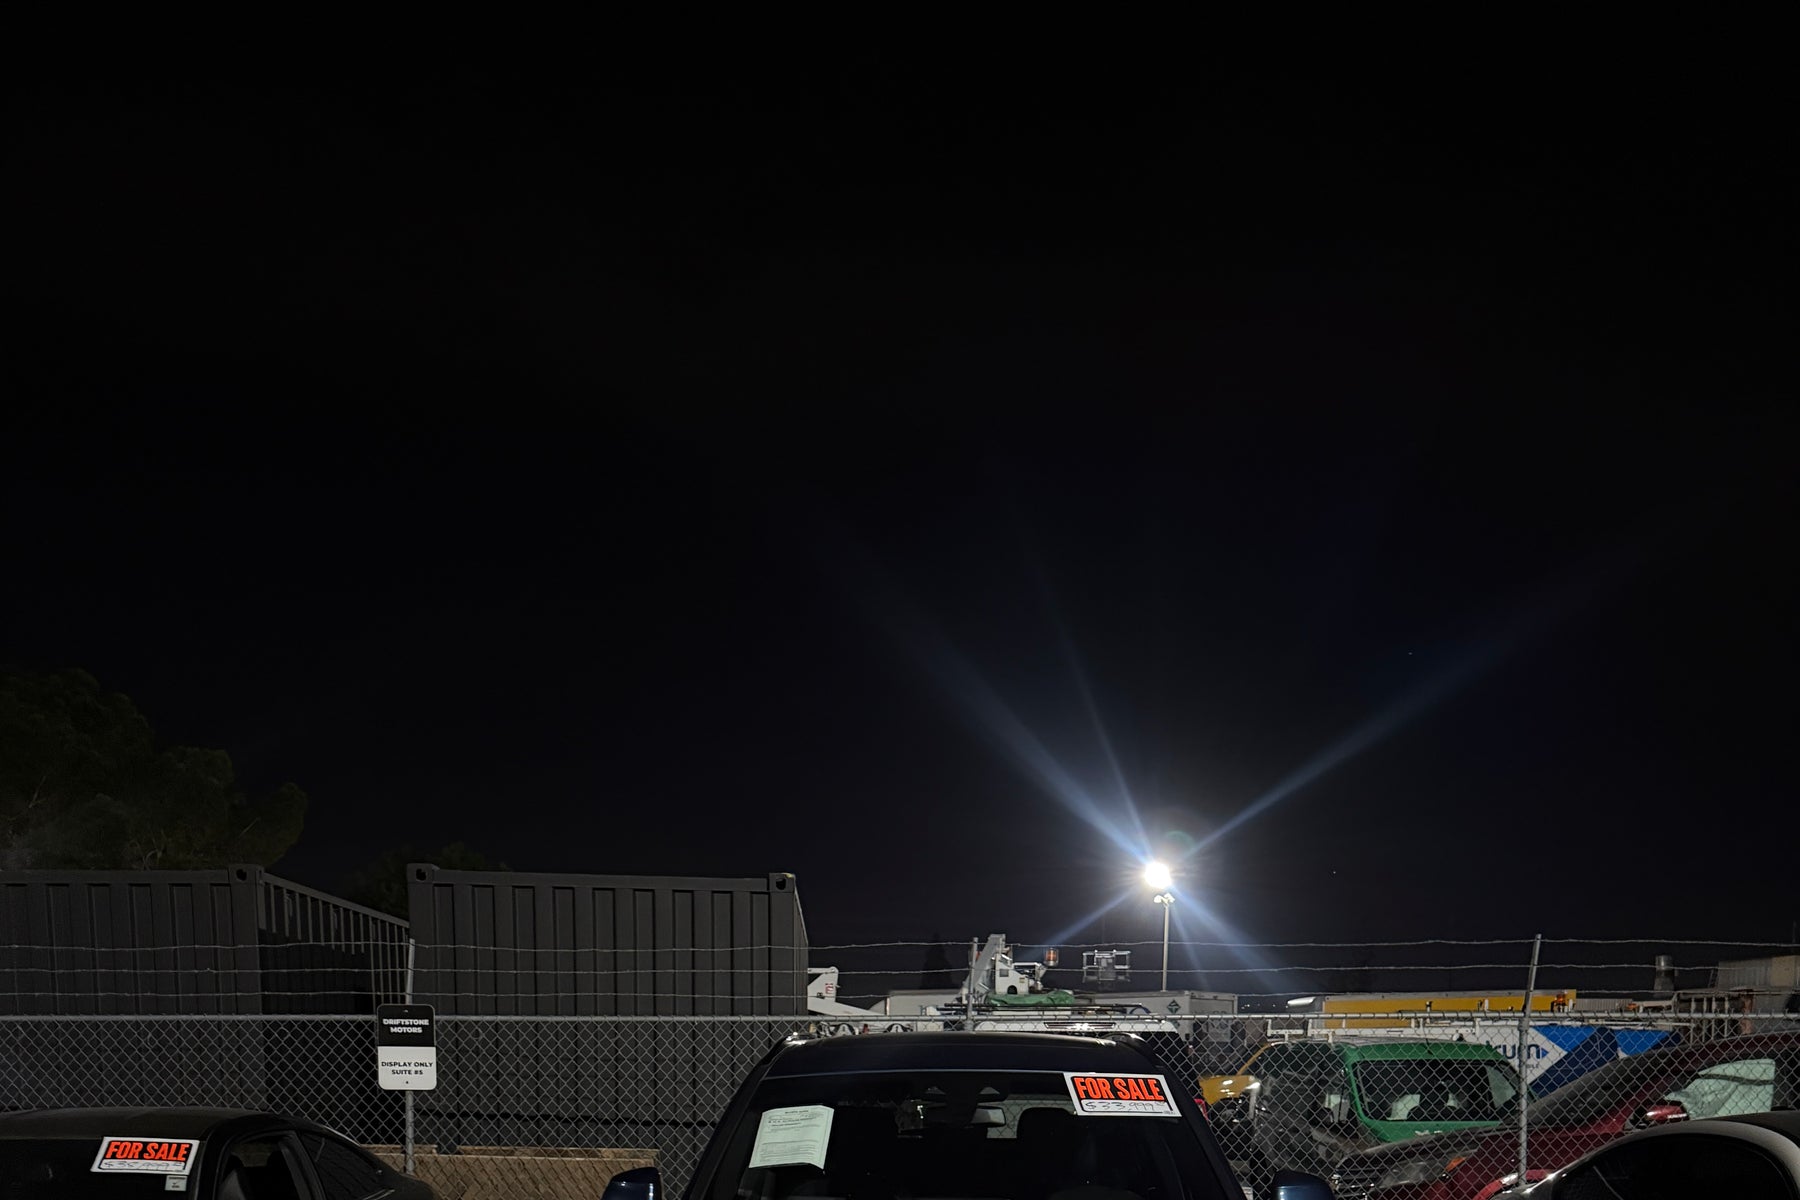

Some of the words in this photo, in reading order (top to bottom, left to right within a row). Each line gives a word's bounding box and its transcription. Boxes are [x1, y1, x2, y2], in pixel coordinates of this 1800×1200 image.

[382, 1018, 430, 1026] DRIFTSTONE
[1073, 1077, 1116, 1099] FOR
[1113, 1077, 1165, 1101] SALE
[105, 1141, 143, 1159] FOR
[143, 1142, 190, 1161] SALE
